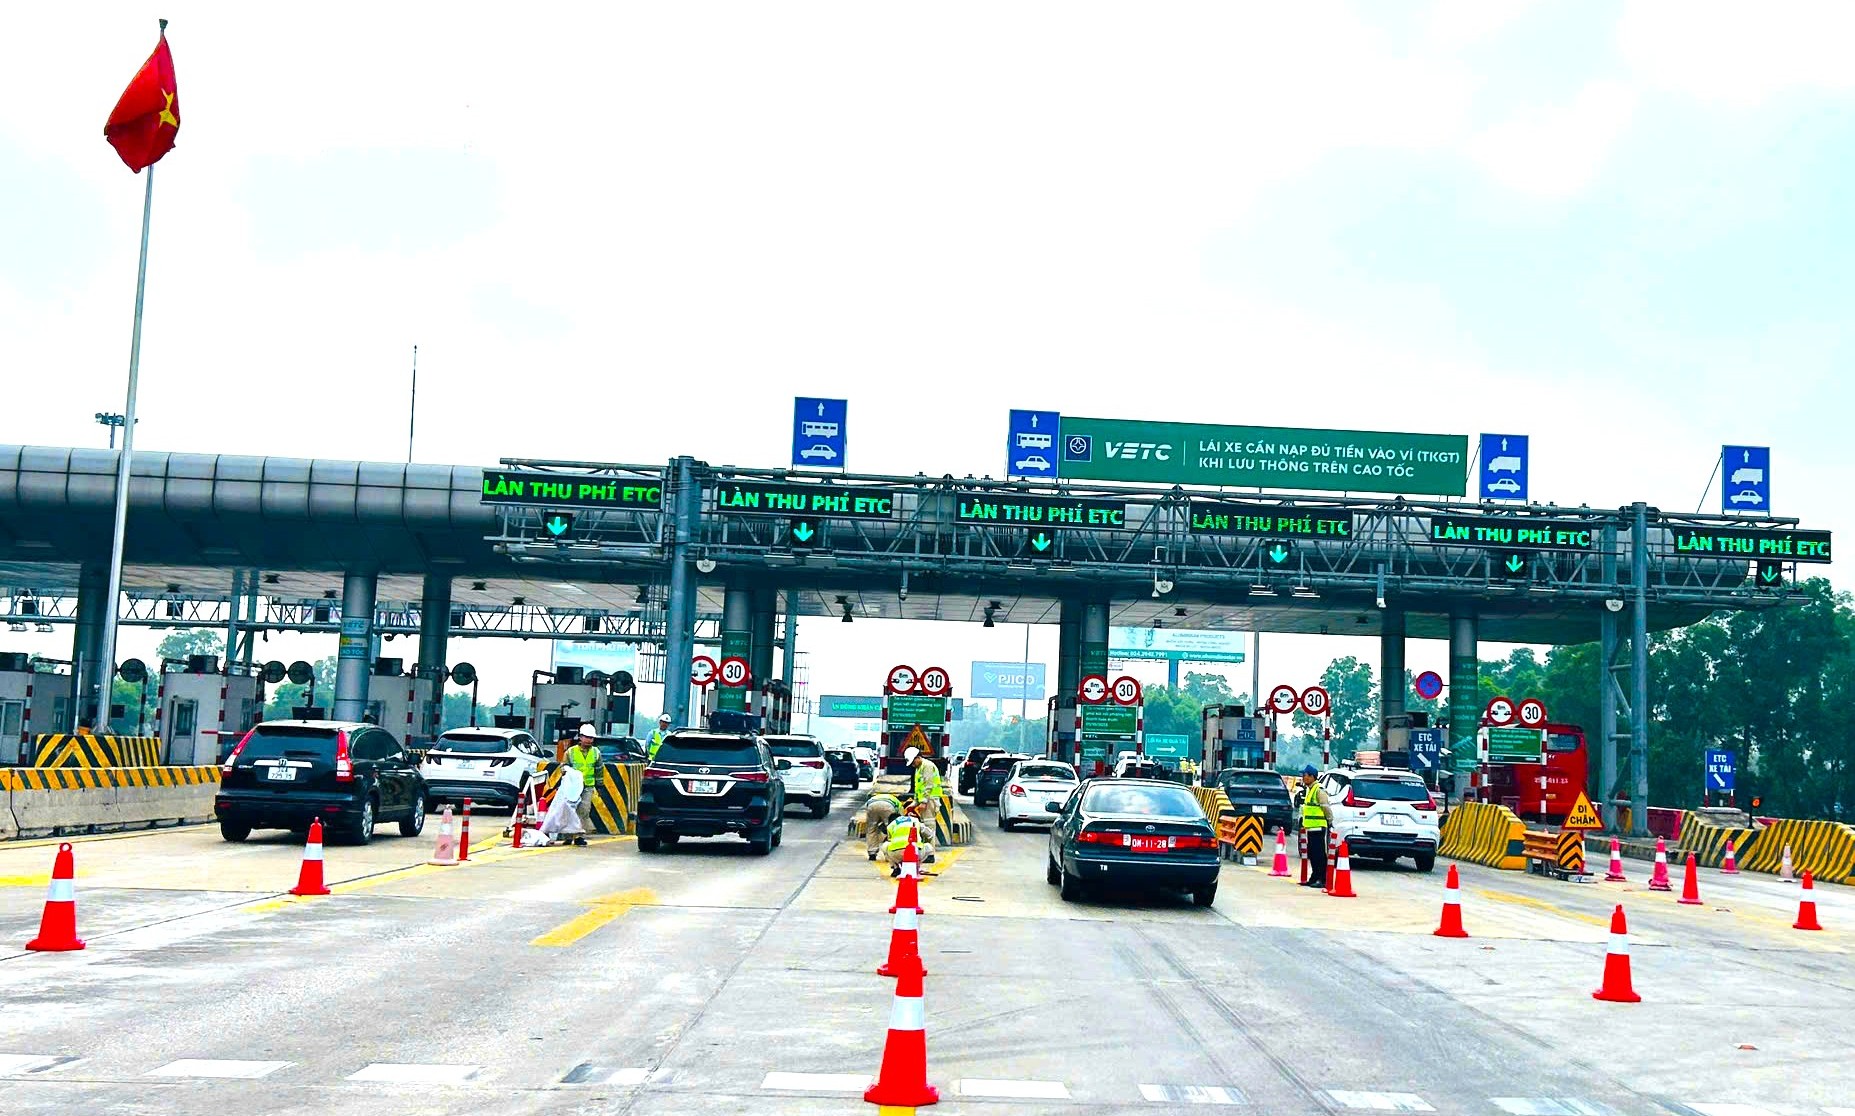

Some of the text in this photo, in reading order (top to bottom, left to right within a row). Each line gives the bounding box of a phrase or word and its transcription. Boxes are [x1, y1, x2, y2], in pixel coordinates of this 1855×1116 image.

[1106, 442, 1171, 460] VETC
[1200, 439, 1220, 451] LÁI
[1225, 442, 1241, 452] XE
[1280, 445, 1307, 457] NẠP
[1311, 443, 1330, 456] ĐỦ
[1368, 449, 1395, 459] VÀO
[1400, 447, 1412, 460] VÍ
[1418, 451, 1459, 463] (TKGT)
[1200, 458, 1413, 476] KHI LƯU THÔNG TRÊN CAO TỐC
[484, 475, 660, 502] LÀN THU PHÍ ETC
[720, 487, 890, 513] LÀN THU PHÍ ETC
[960, 499, 1123, 524] LÀN THU PHÍ ETC
[1193, 510, 1348, 535] LÀN THU PHÍ ETC
[1434, 522, 1589, 546] LÀN THU PHÍ ETC
[1678, 532, 1829, 556] LÀN THU PHÍ ETC
[726, 664, 742, 679] 30
[927, 674, 942, 688] 30
[1119, 684, 1133, 697] 30
[1307, 694, 1322, 708] 30
[1525, 706, 1539, 720] 30
[1418, 733, 1433, 742] ETC
[1413, 743, 1424, 752] XE
[1713, 754, 1727, 763] ETC
[1709, 764, 1718, 773] XE
[1577, 805, 1587, 813] ĐI
[1570, 814, 1595, 826] CHẬM
